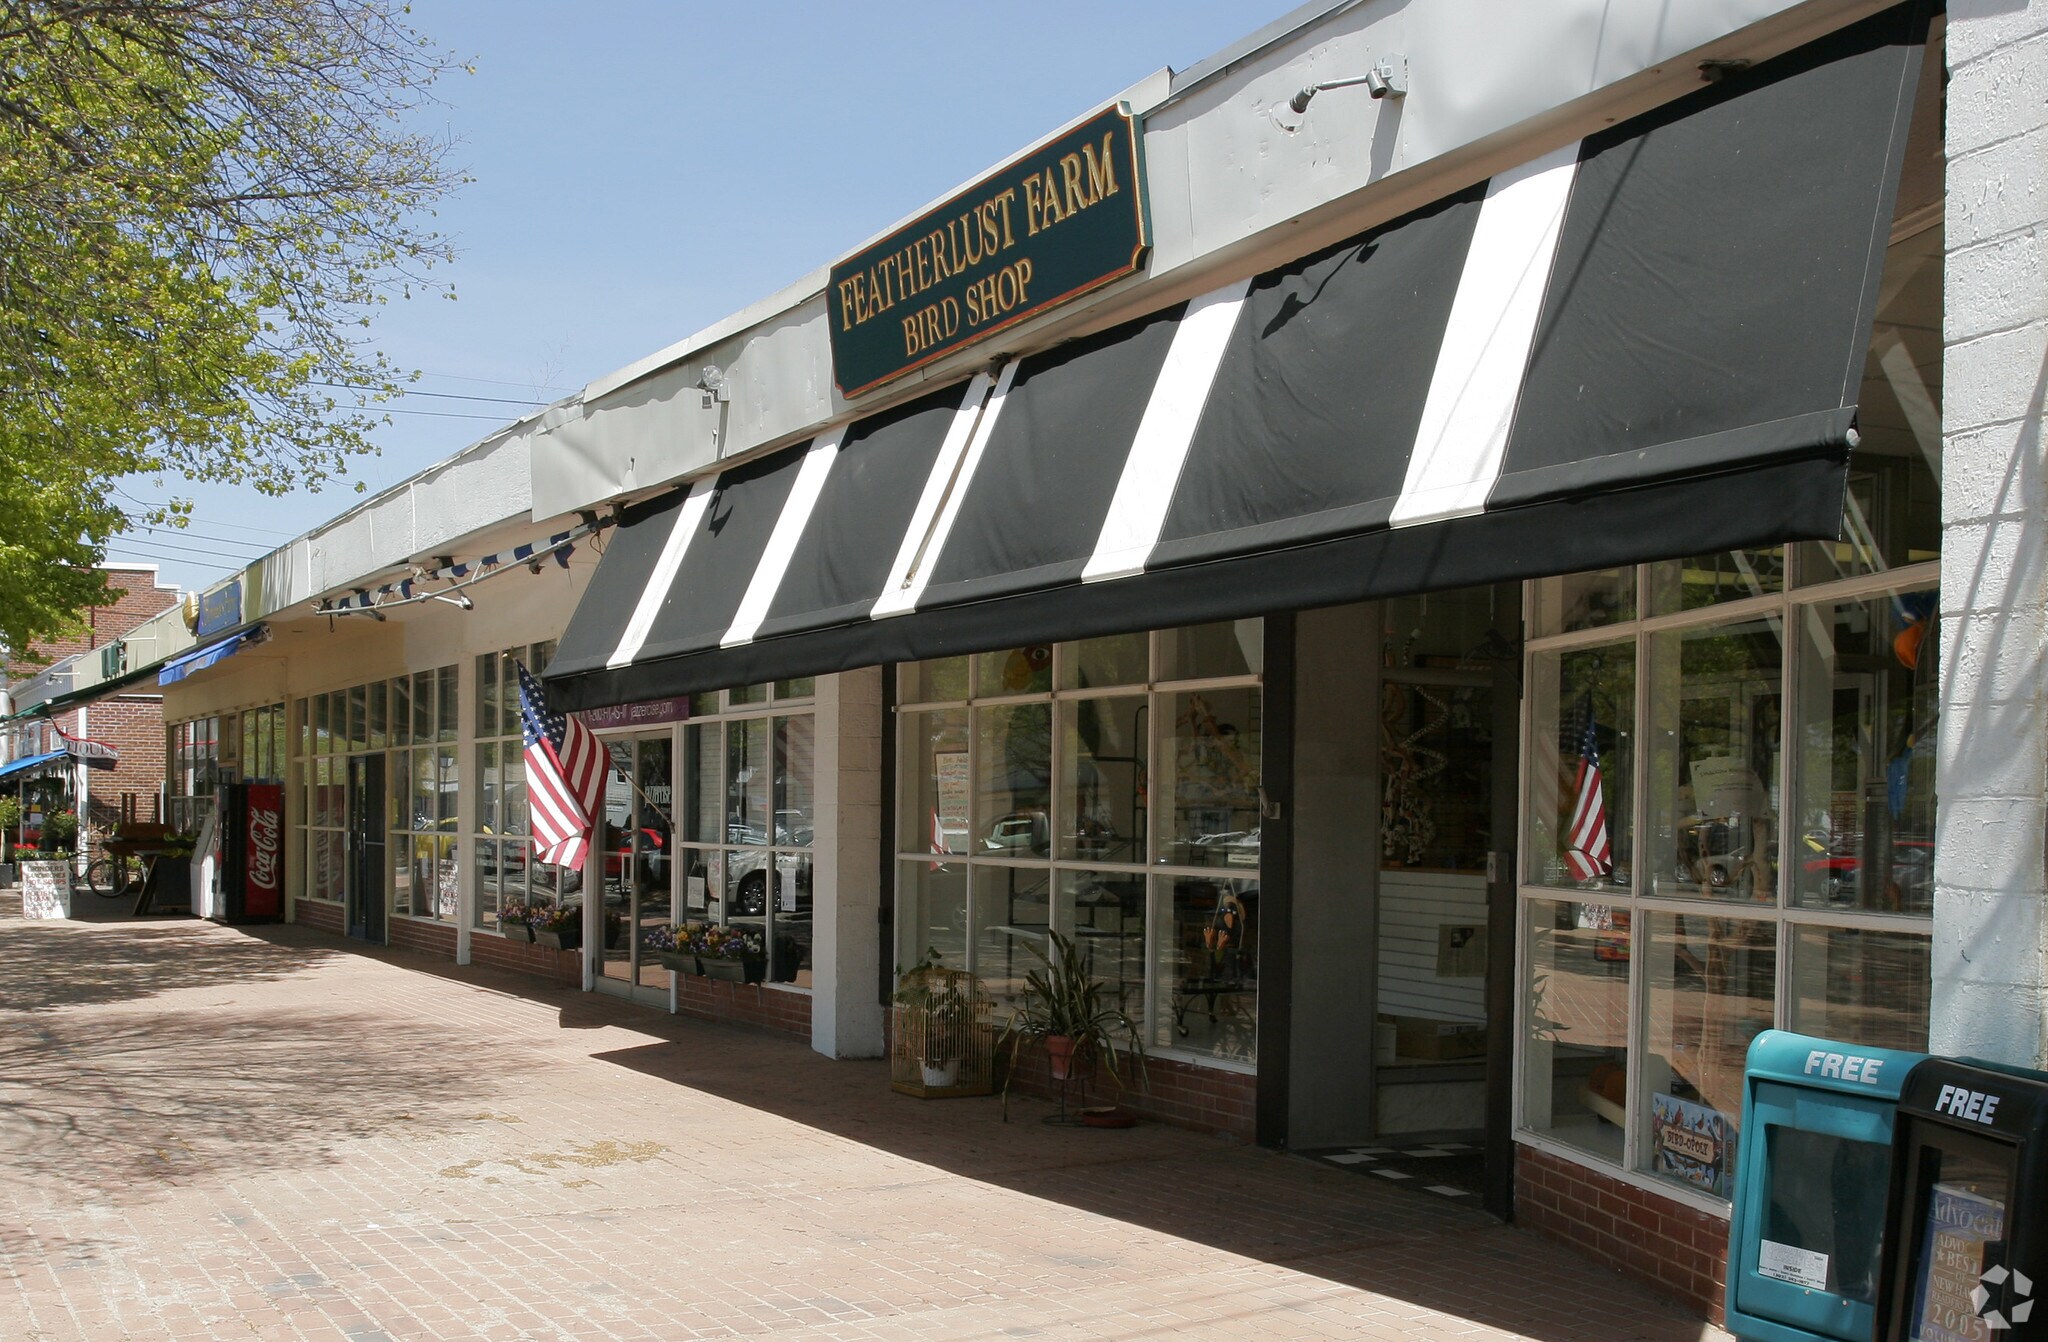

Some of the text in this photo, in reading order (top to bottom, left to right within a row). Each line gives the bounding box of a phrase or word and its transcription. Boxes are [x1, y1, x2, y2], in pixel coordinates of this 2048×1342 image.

[838, 131, 1119, 332] FEATHERLUST FARM
[901, 257, 1033, 358] BIRD SHOP
[62, 739, 117, 757] TIQUES
[249, 806, 279, 890] Coca-Cola
[1804, 1050, 1884, 1085] FREE
[1934, 1084, 2000, 1125] FREE
[1666, 1130, 1709, 1156] BIRD-OPOLY
[1933, 1193, 2003, 1238] Advocat
[1937, 1234, 1967, 1252] ADVO
[1933, 1275, 1974, 1298] NEW HAV
[1955, 1272, 1967, 1282] OF
[1931, 1290, 1965, 1311] READERS
[1931, 1303, 1984, 1341] 2005
